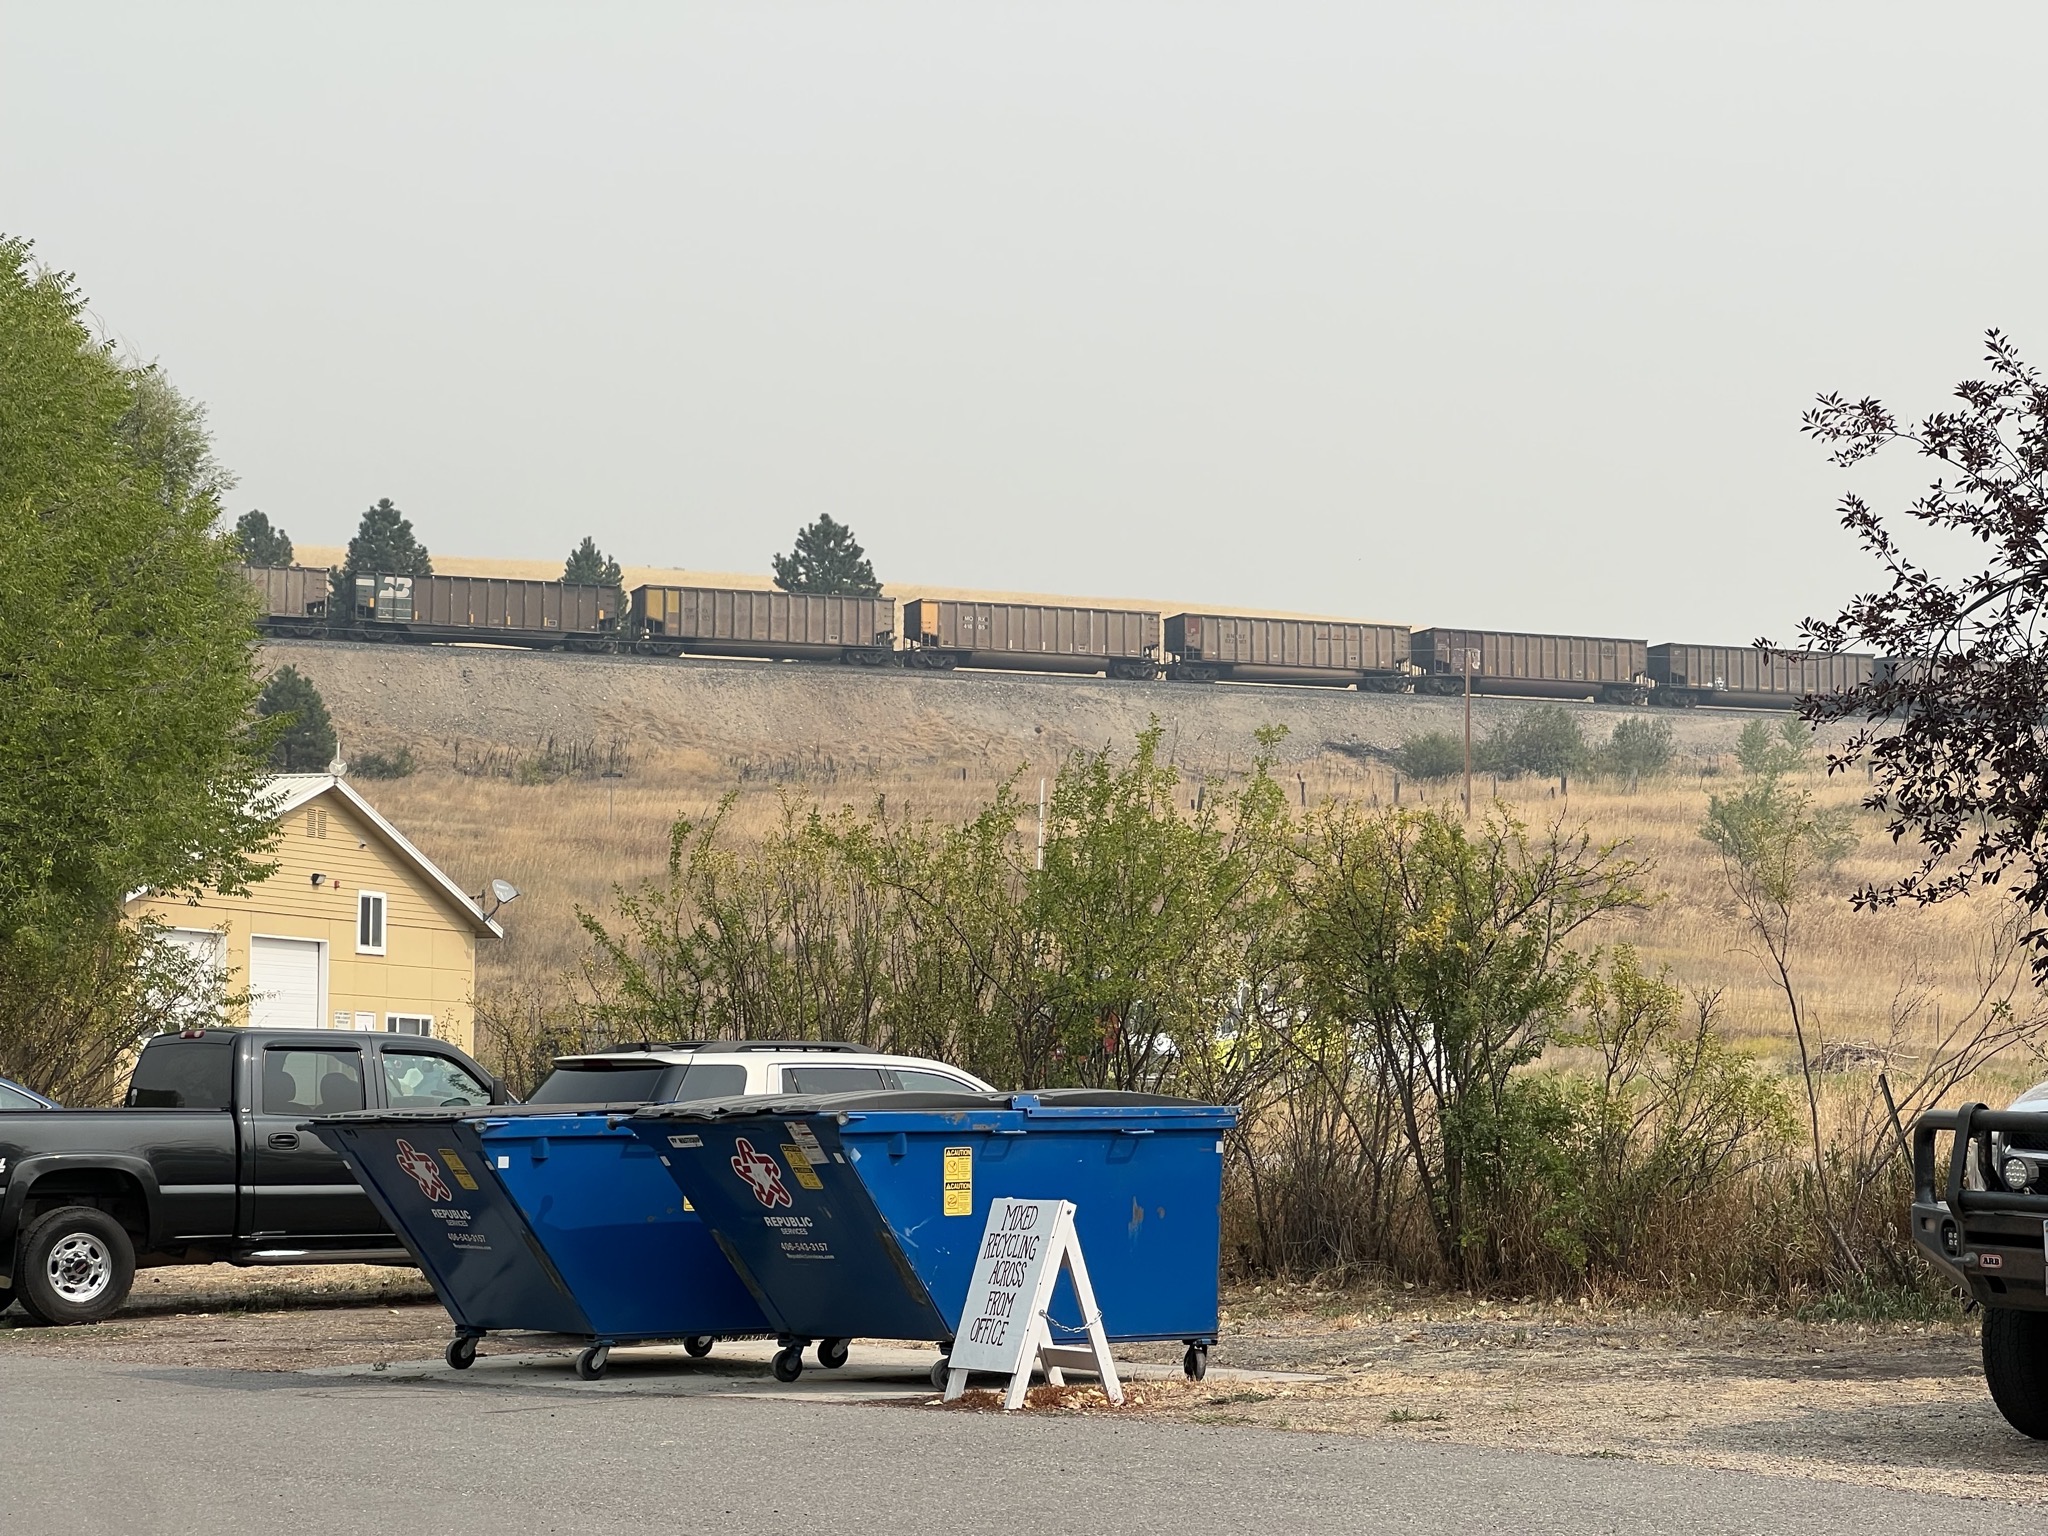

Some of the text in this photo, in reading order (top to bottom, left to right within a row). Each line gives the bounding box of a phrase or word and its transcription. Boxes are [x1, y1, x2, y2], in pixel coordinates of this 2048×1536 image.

[951, 1182, 971, 1190] CAUTION
[431, 1208, 472, 1220] REPUBLIC
[763, 1216, 813, 1227] REPUBLIC
[1001, 1204, 1039, 1231] MIXED
[983, 1232, 1040, 1261] RECYCLING
[988, 1260, 1028, 1288] ACROSS
[1983, 1257, 2000, 1266] ARB
[984, 1290, 1017, 1318] FROM
[969, 1317, 1010, 1347] OFFICE
